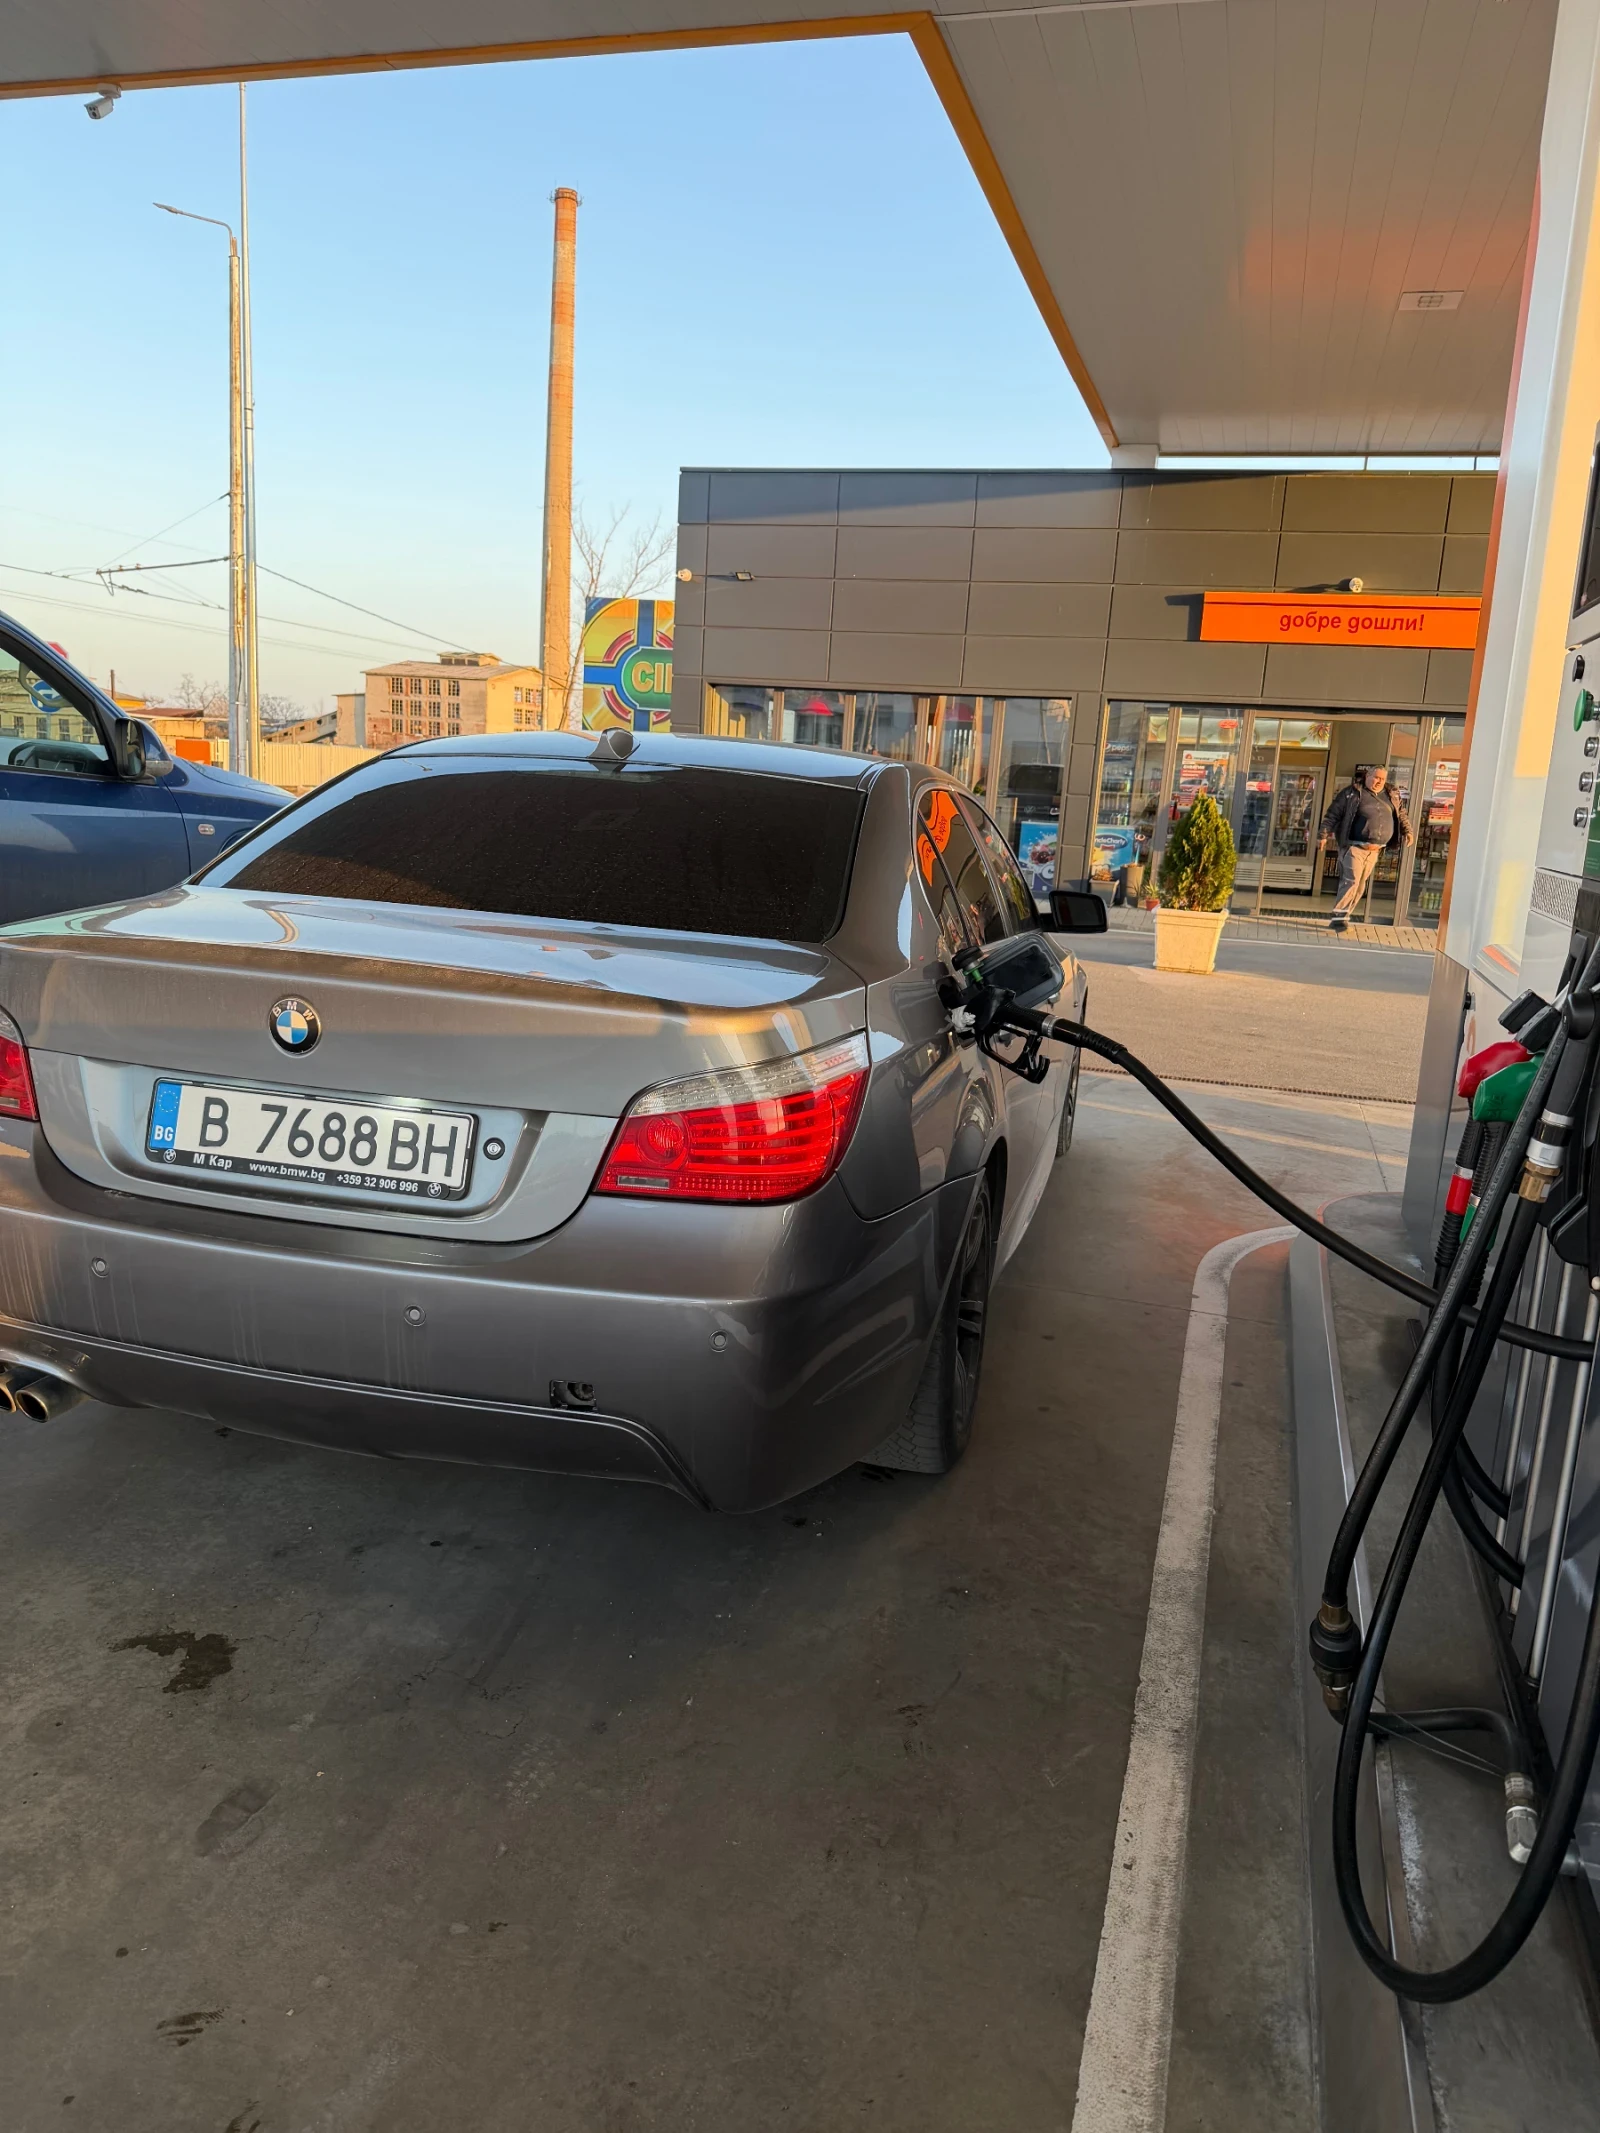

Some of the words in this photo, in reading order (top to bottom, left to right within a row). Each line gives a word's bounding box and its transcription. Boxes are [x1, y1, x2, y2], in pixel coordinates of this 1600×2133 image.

[1280, 611, 1341, 632] добре
[1348, 614, 1424, 633] дошли!
[271, 1000, 315, 1022] BMW
[154, 1124, 174, 1142] BG
[198, 1096, 230, 1148] B
[255, 1103, 379, 1167] 7688
[387, 1119, 459, 1178] BH
[249, 1161, 326, 1182] www.bmw.bg
[336, 1173, 362, 1186] +359
[364, 1175, 376, 1188] 32
[379, 1178, 398, 1191] 906
[399, 1180, 419, 1193] 996
